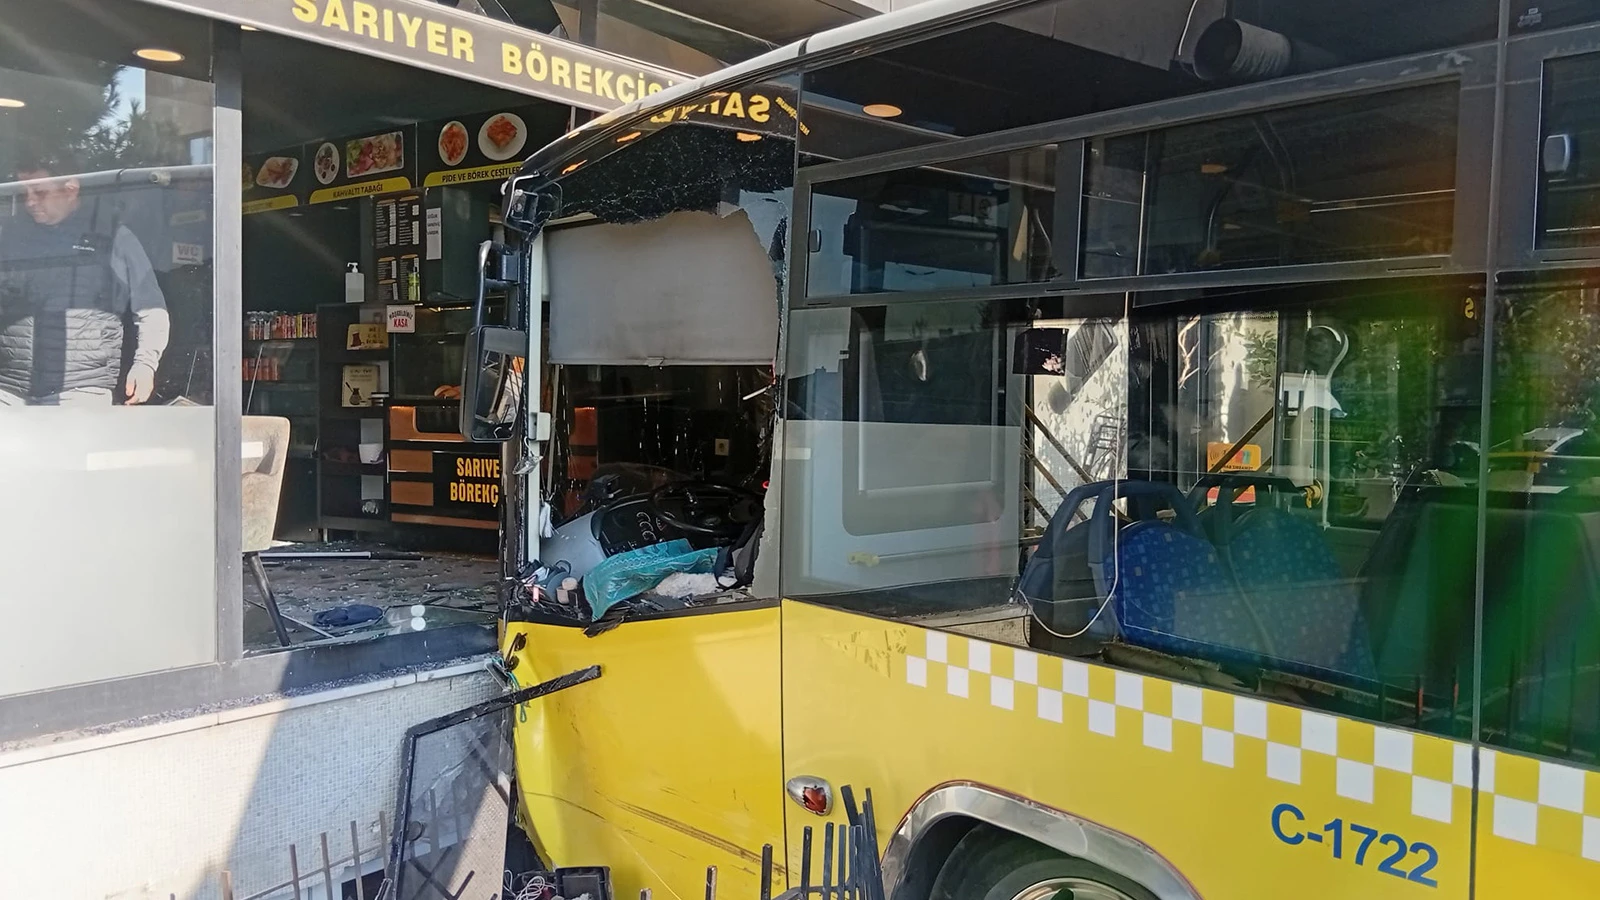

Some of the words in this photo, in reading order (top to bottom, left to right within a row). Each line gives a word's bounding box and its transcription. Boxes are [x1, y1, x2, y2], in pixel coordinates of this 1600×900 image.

[292, 0, 475, 63] SARIYER
[501, 43, 673, 104] BÖREKÇİS
[361, 182, 383, 194] TABAĞI
[177, 244, 198, 257] WC
[393, 318, 408, 328] KASA
[1271, 803, 1439, 889] C-1722
